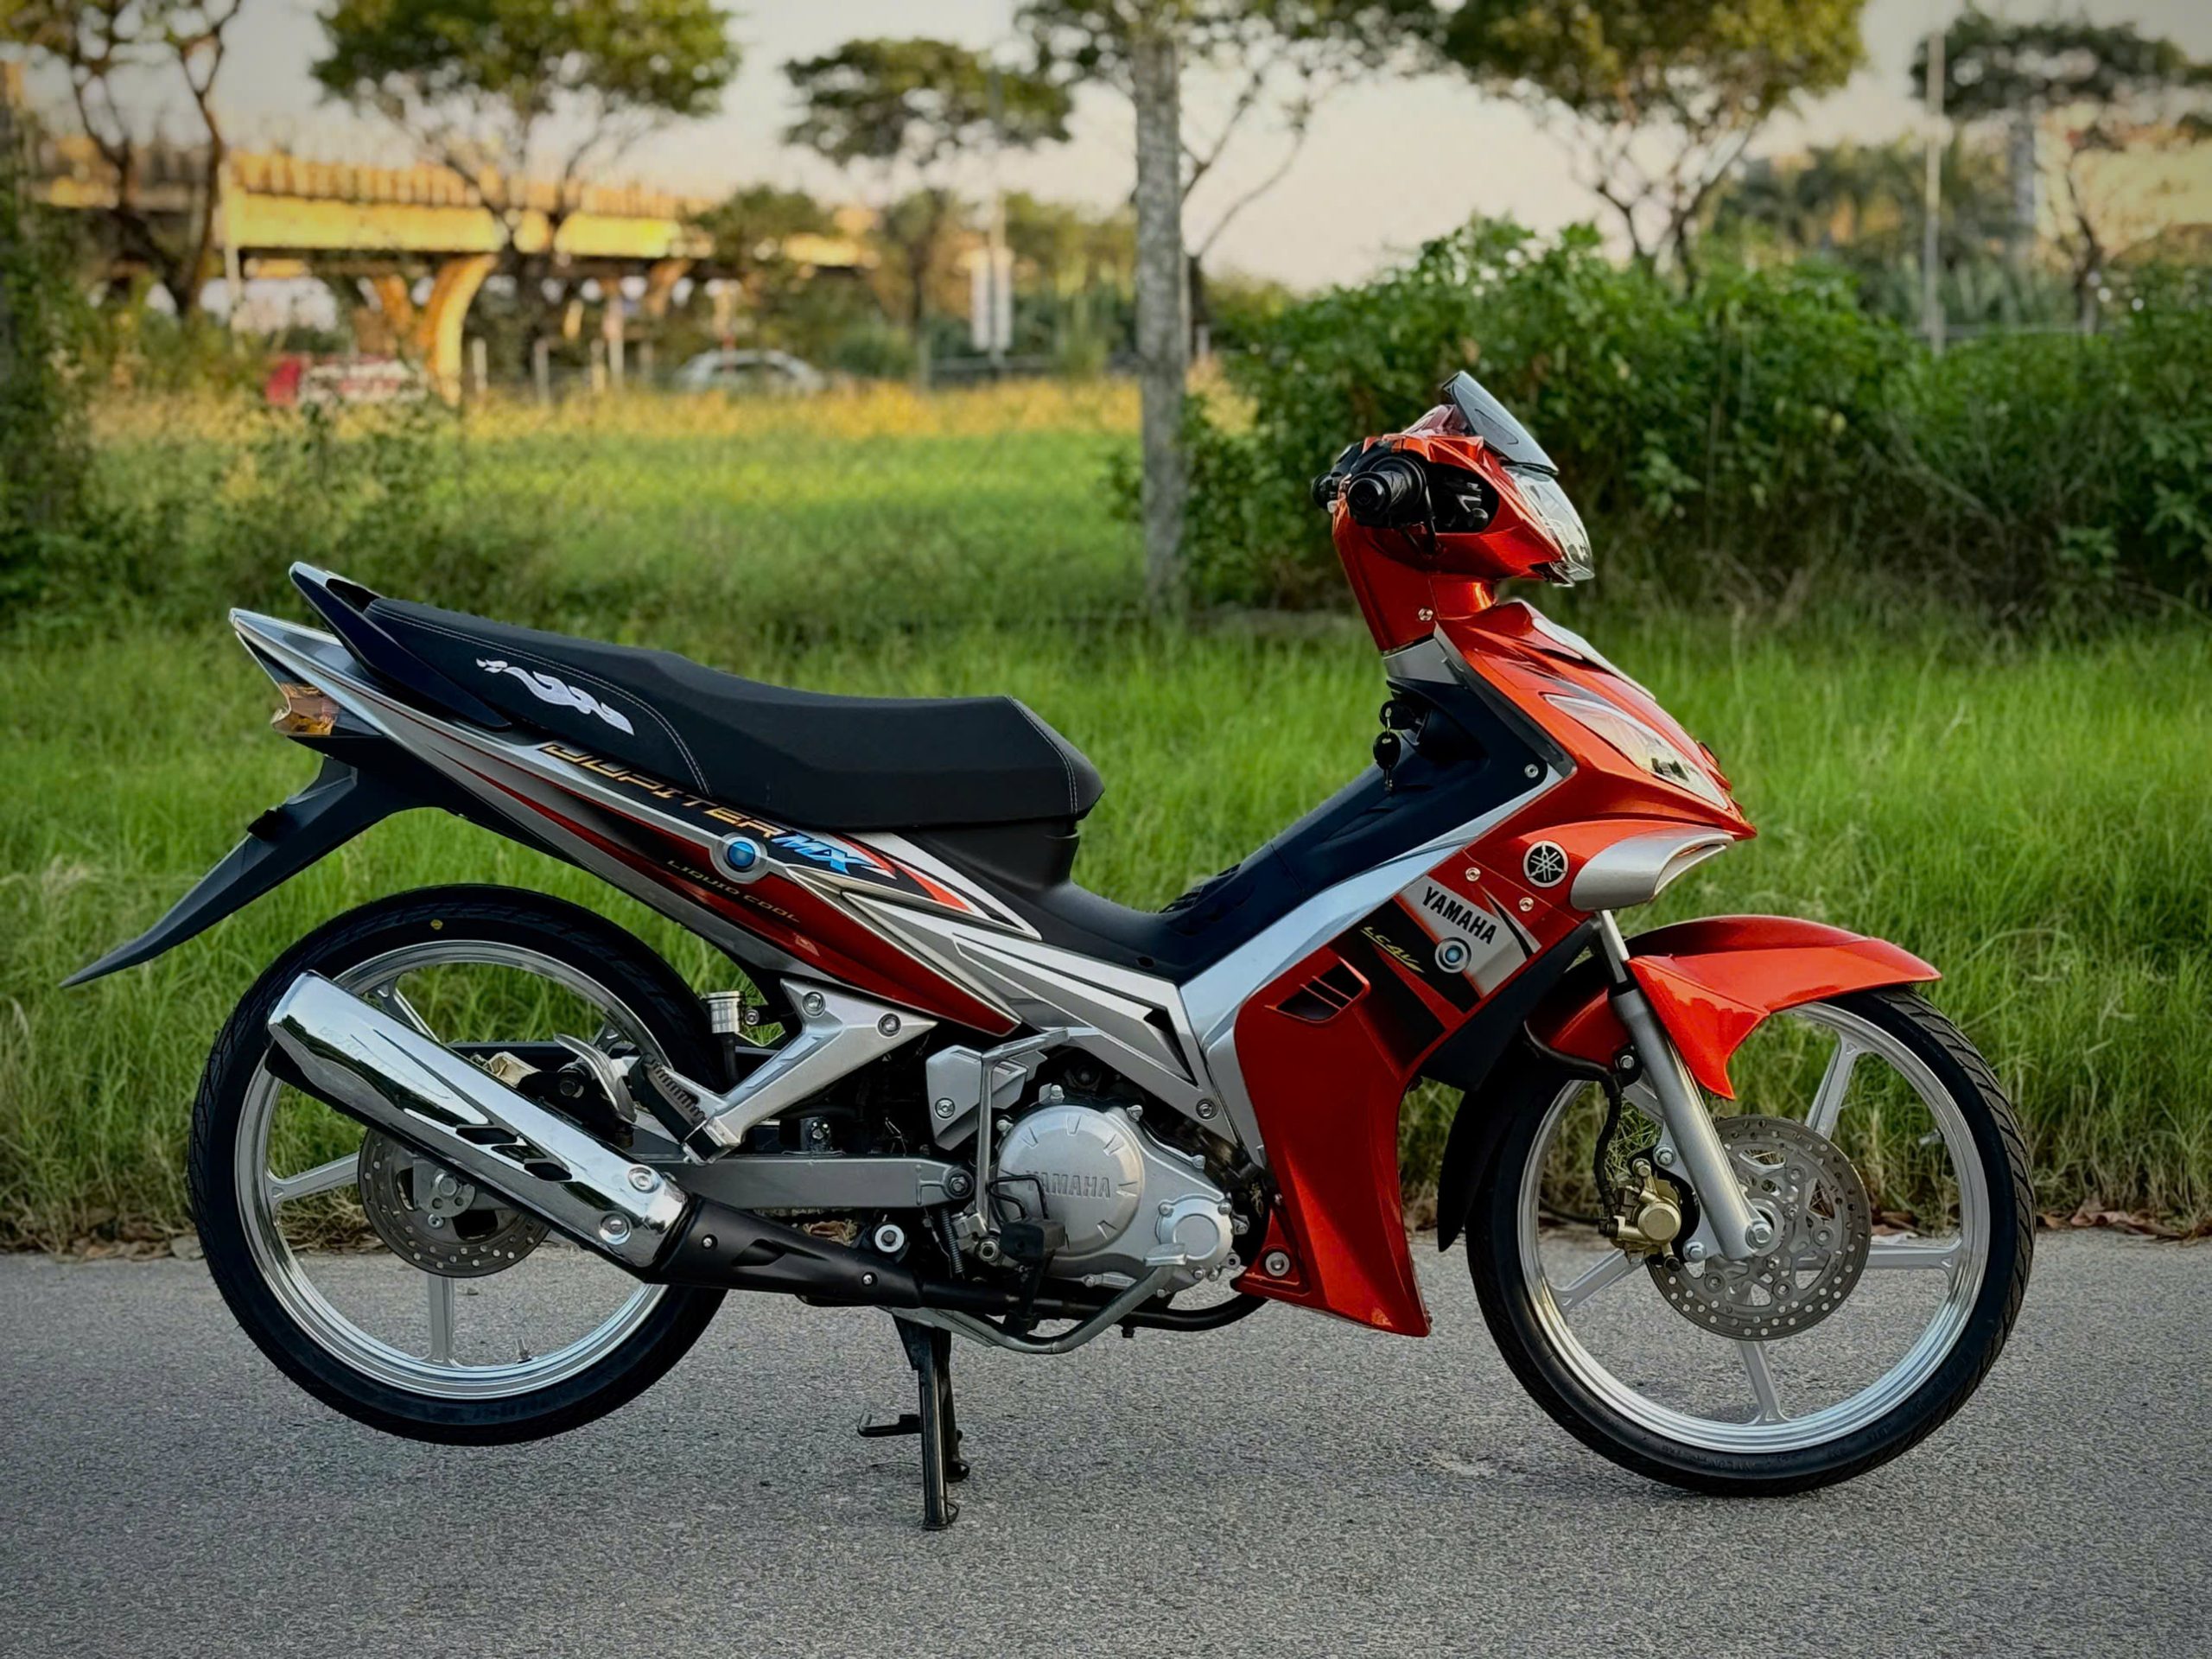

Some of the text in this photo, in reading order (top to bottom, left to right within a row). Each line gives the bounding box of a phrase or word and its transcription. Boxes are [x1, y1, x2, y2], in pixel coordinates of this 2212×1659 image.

[538, 741, 875, 875] JUPITER MX
[666, 859, 801, 925] LIQUID COOL
[1421, 886, 1498, 945] YAMAHA
